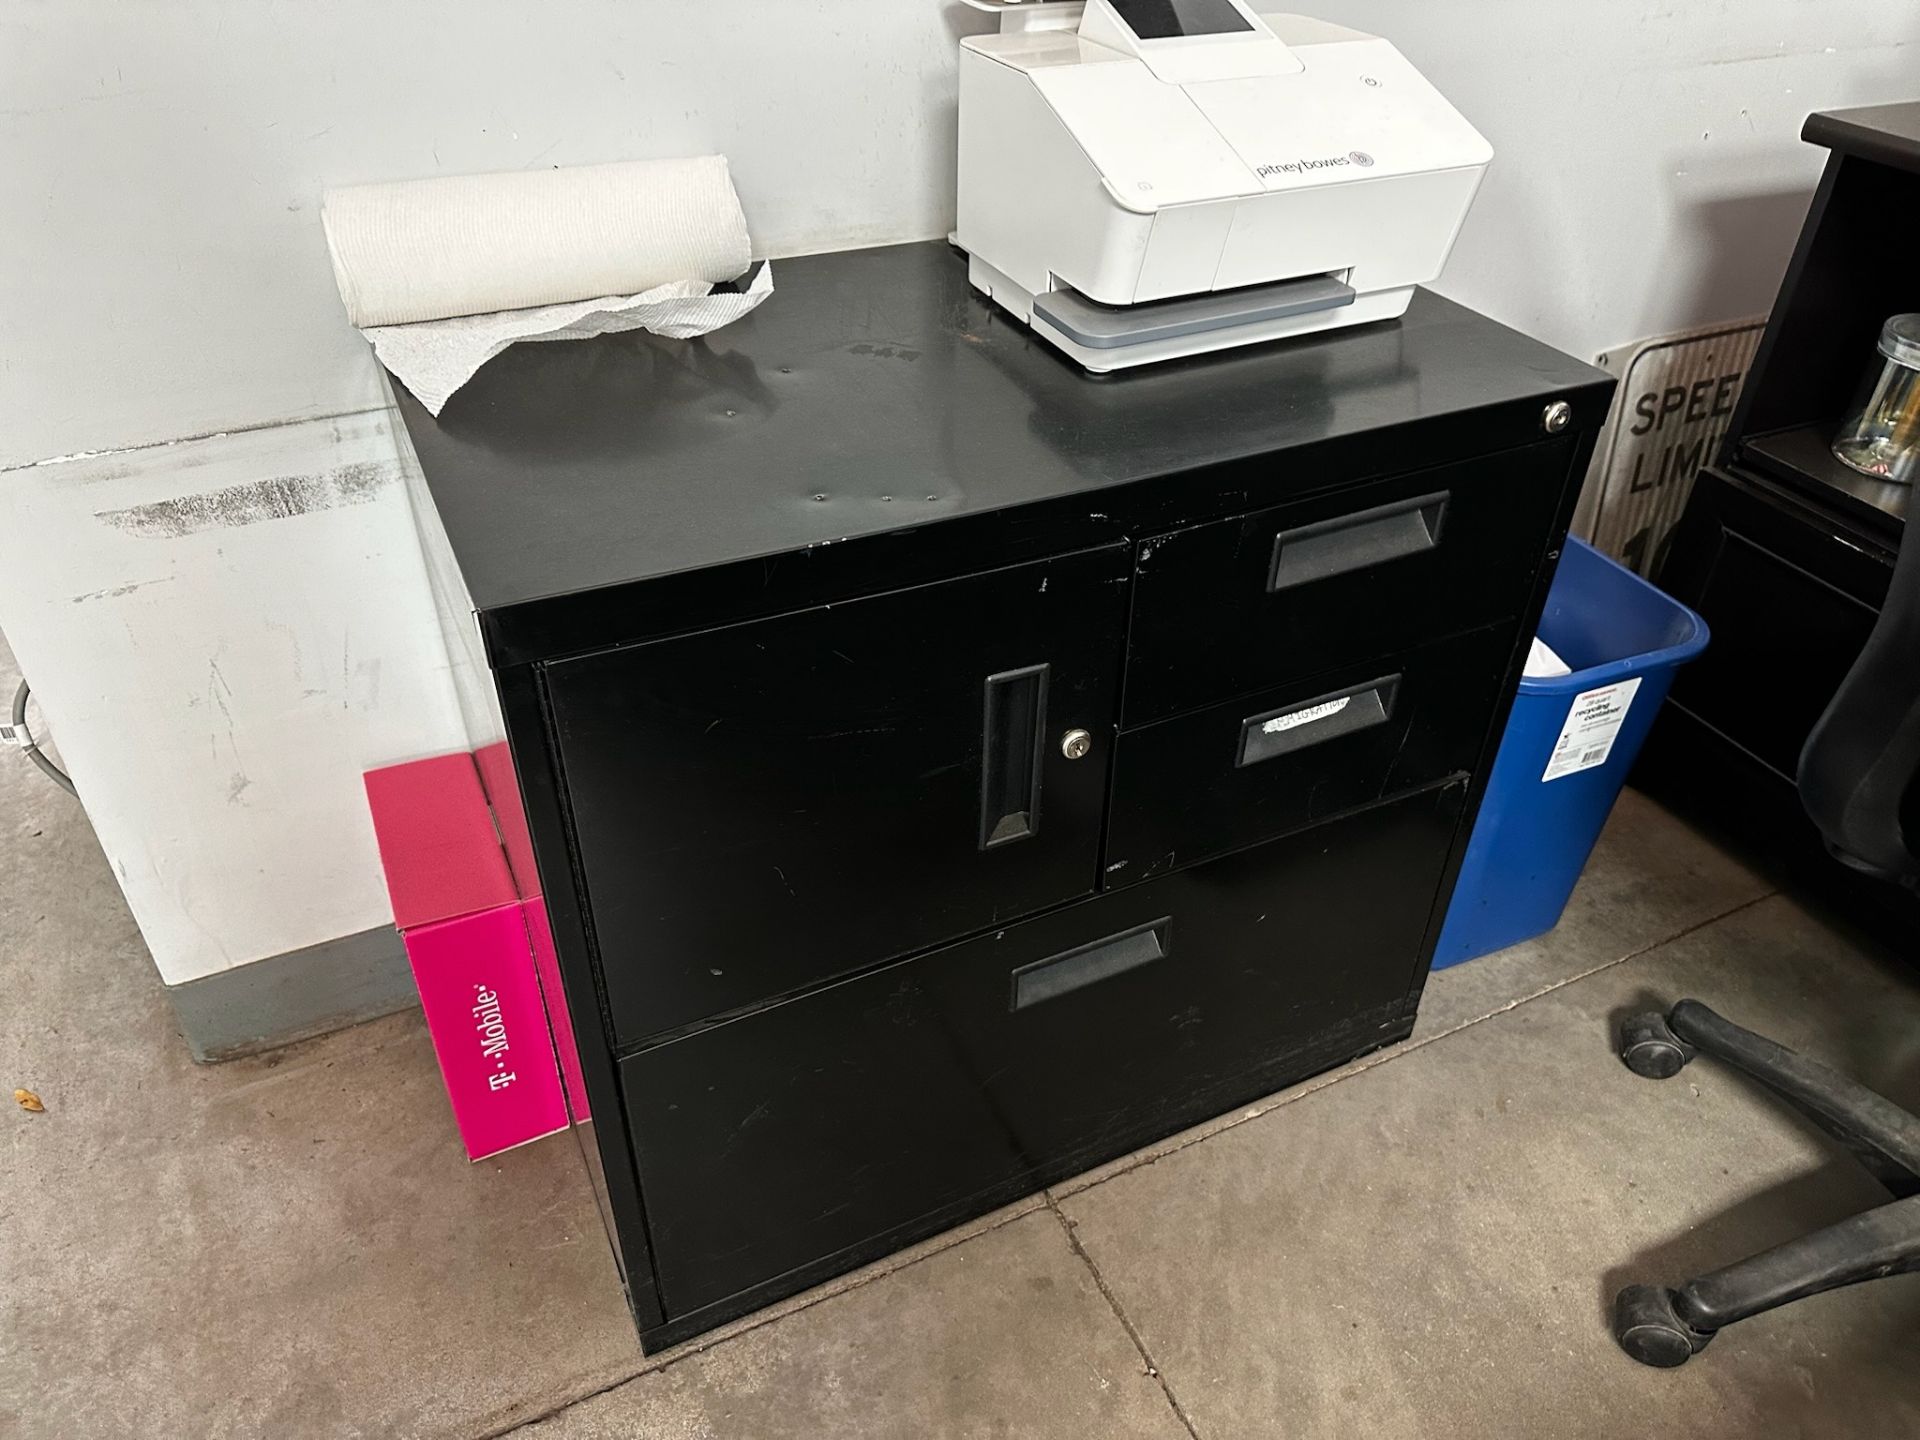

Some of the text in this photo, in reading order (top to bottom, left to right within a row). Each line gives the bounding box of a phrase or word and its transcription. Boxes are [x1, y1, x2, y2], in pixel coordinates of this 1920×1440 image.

[1257, 156, 1350, 178] pitney bowes
[1631, 372, 1741, 436] SPEE
[1630, 434, 1724, 493] LIMI
[1575, 703, 1610, 717] recycling
[1584, 706, 1621, 721] container
